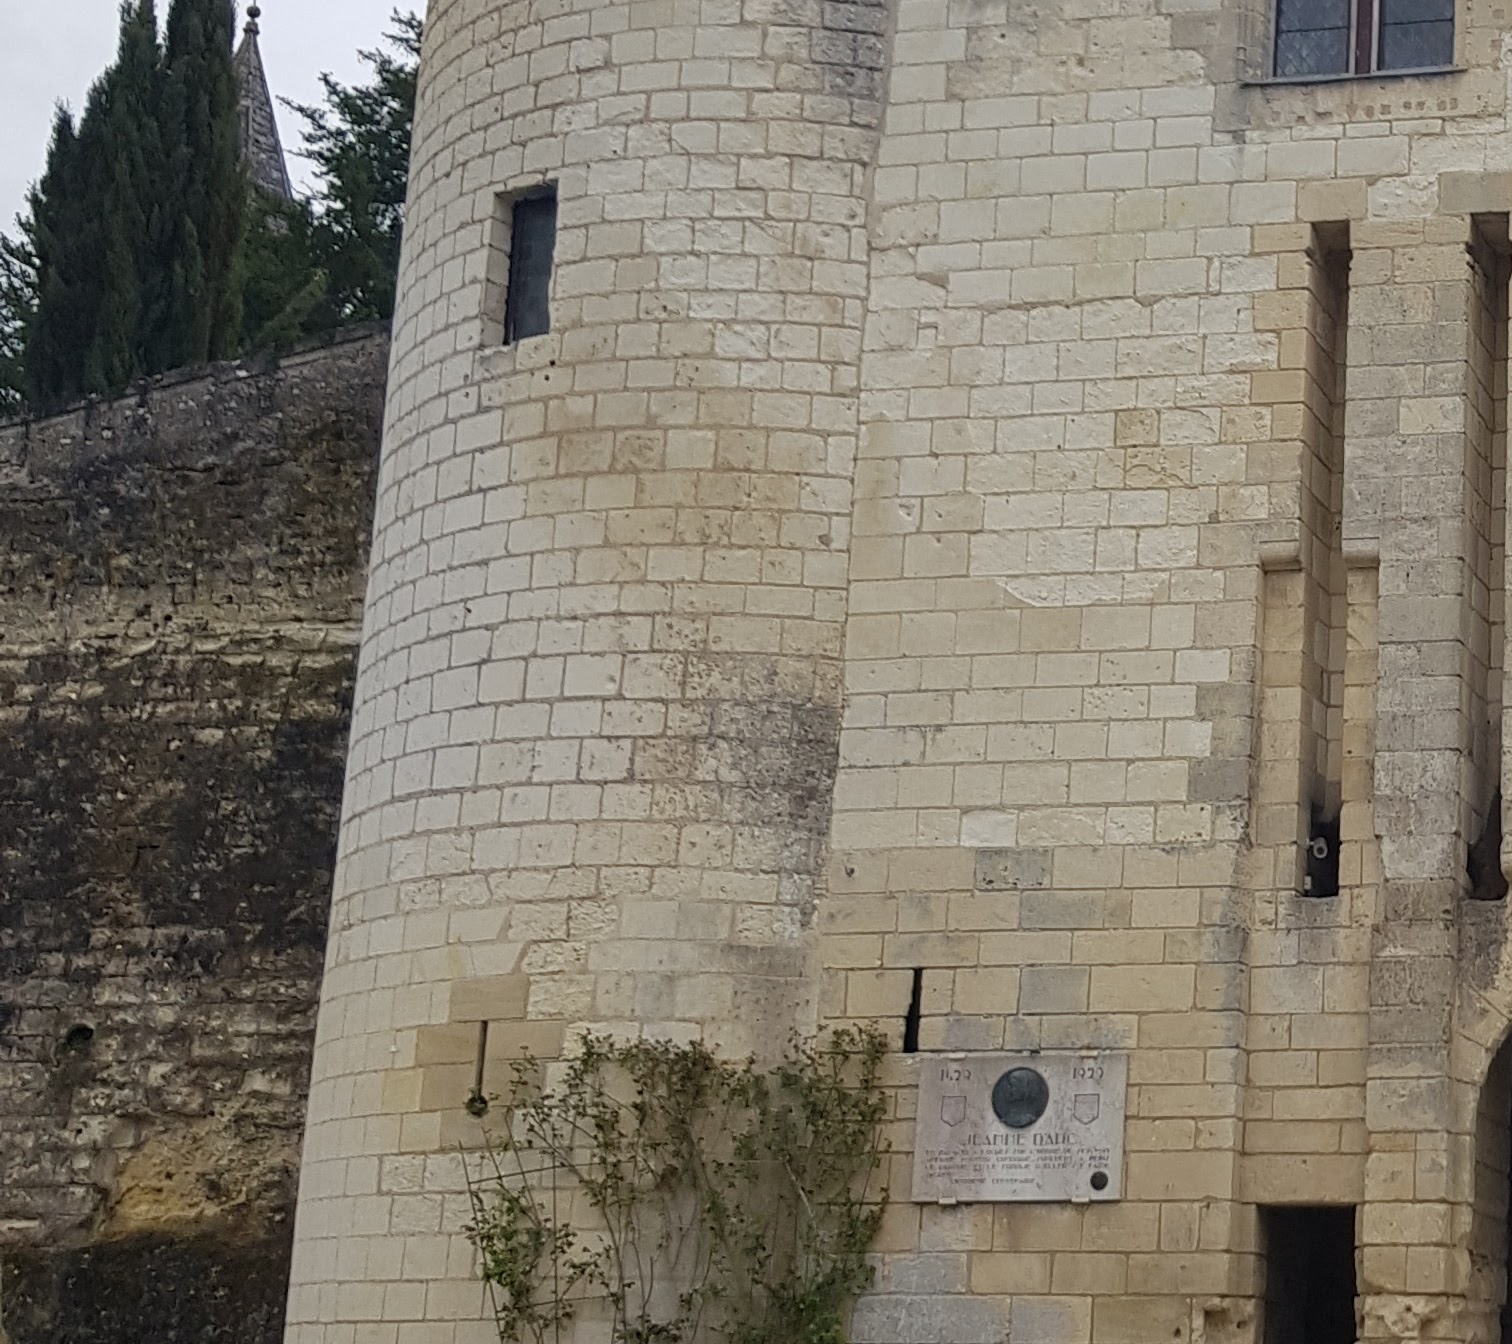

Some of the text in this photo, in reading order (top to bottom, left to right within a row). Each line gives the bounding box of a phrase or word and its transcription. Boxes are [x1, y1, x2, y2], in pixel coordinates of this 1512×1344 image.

[1072, 1066, 1104, 1079] 1929
[963, 1133, 1077, 1146] JEANNE D'ARC
